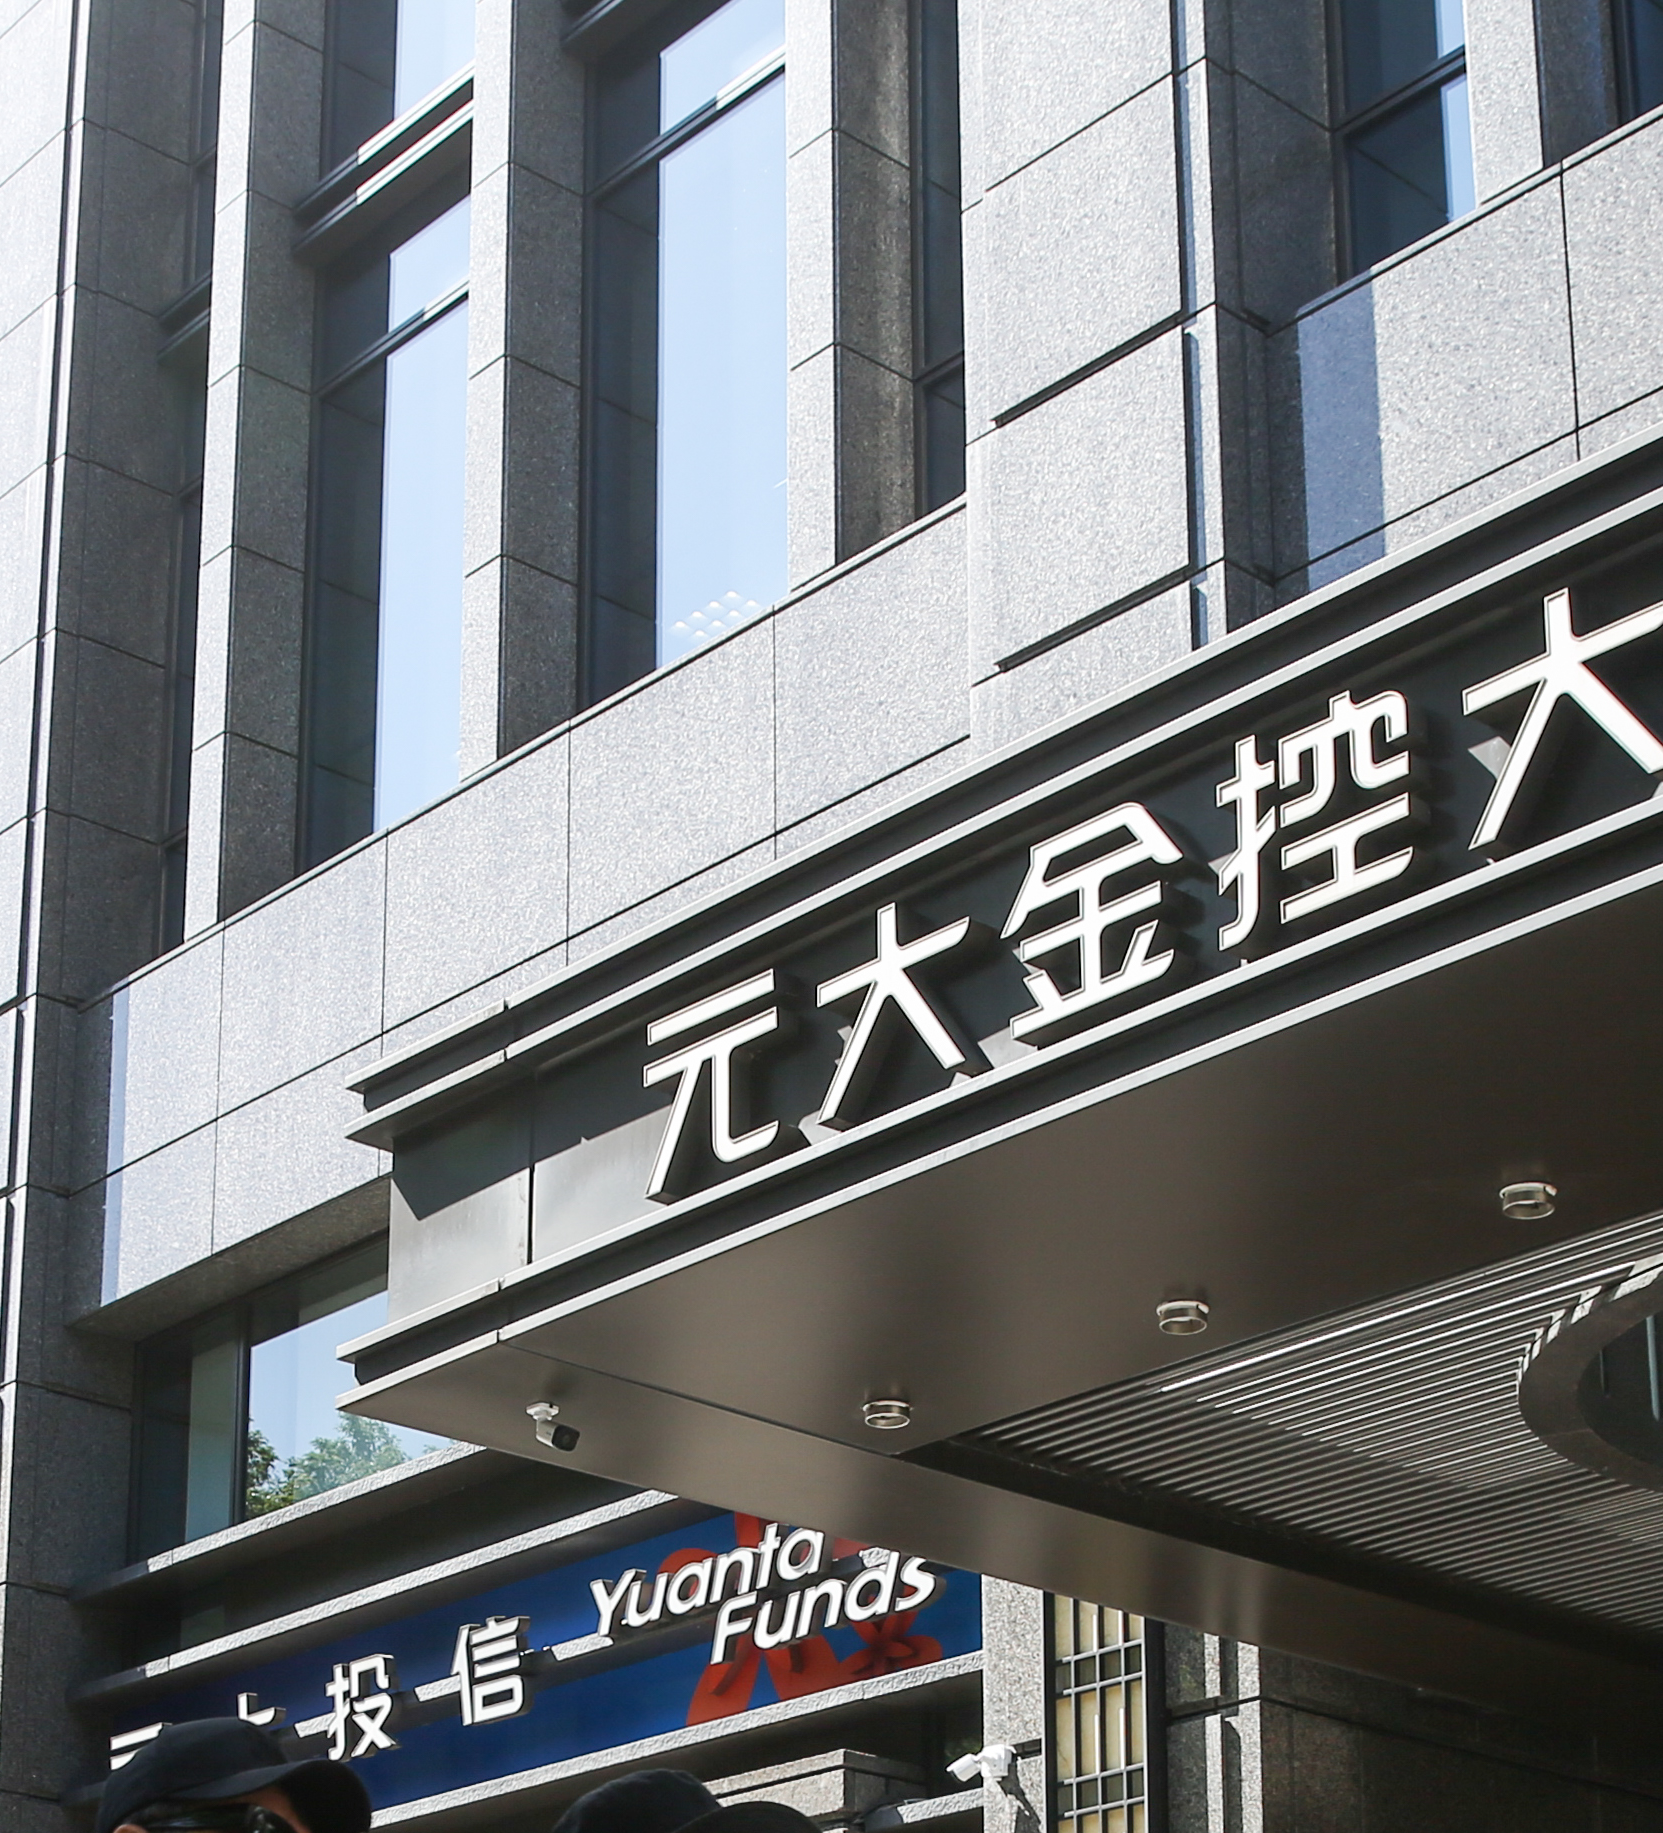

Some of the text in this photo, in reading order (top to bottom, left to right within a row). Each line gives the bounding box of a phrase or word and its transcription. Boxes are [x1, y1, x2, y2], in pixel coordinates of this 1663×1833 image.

[591, 1523, 824, 1636] Yuanta
[710, 1551, 936, 1664] Funds
[109, 1616, 530, 1762] 投信
